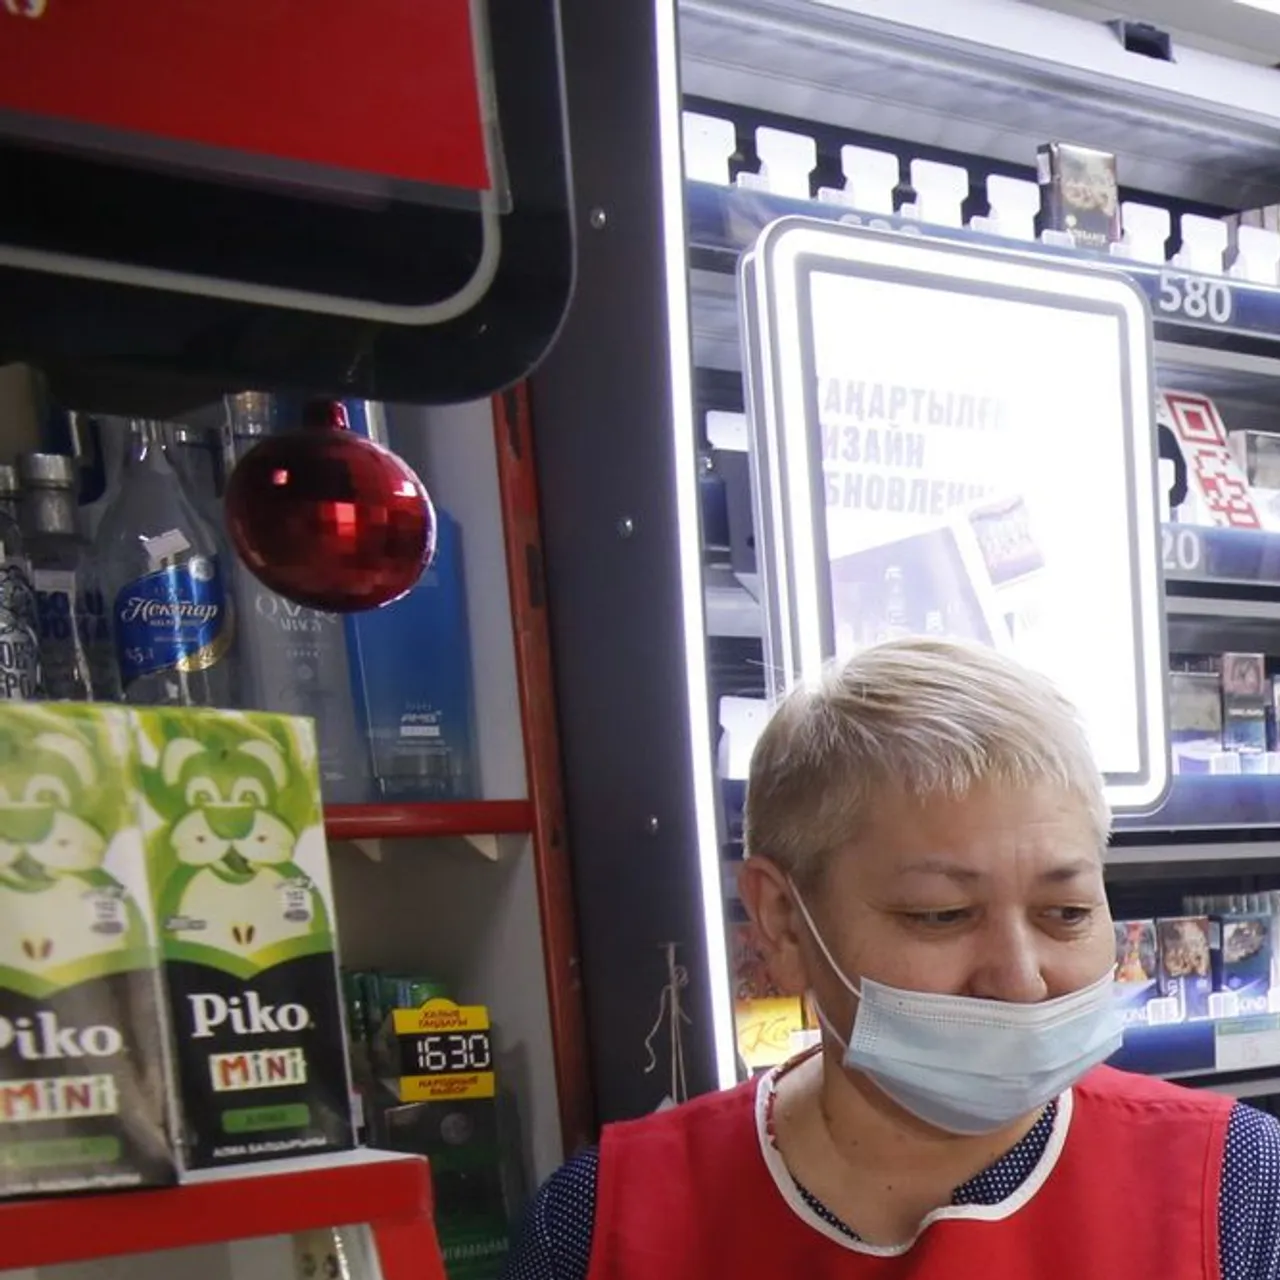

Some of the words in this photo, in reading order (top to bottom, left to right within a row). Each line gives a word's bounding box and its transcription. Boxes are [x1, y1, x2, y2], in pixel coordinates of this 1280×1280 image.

[1159, 275, 1232, 324] 580
[822, 424, 926, 468] ИЗАЙН
[187, 991, 310, 1038] Piko
[416, 1034, 491, 1071] 1630
